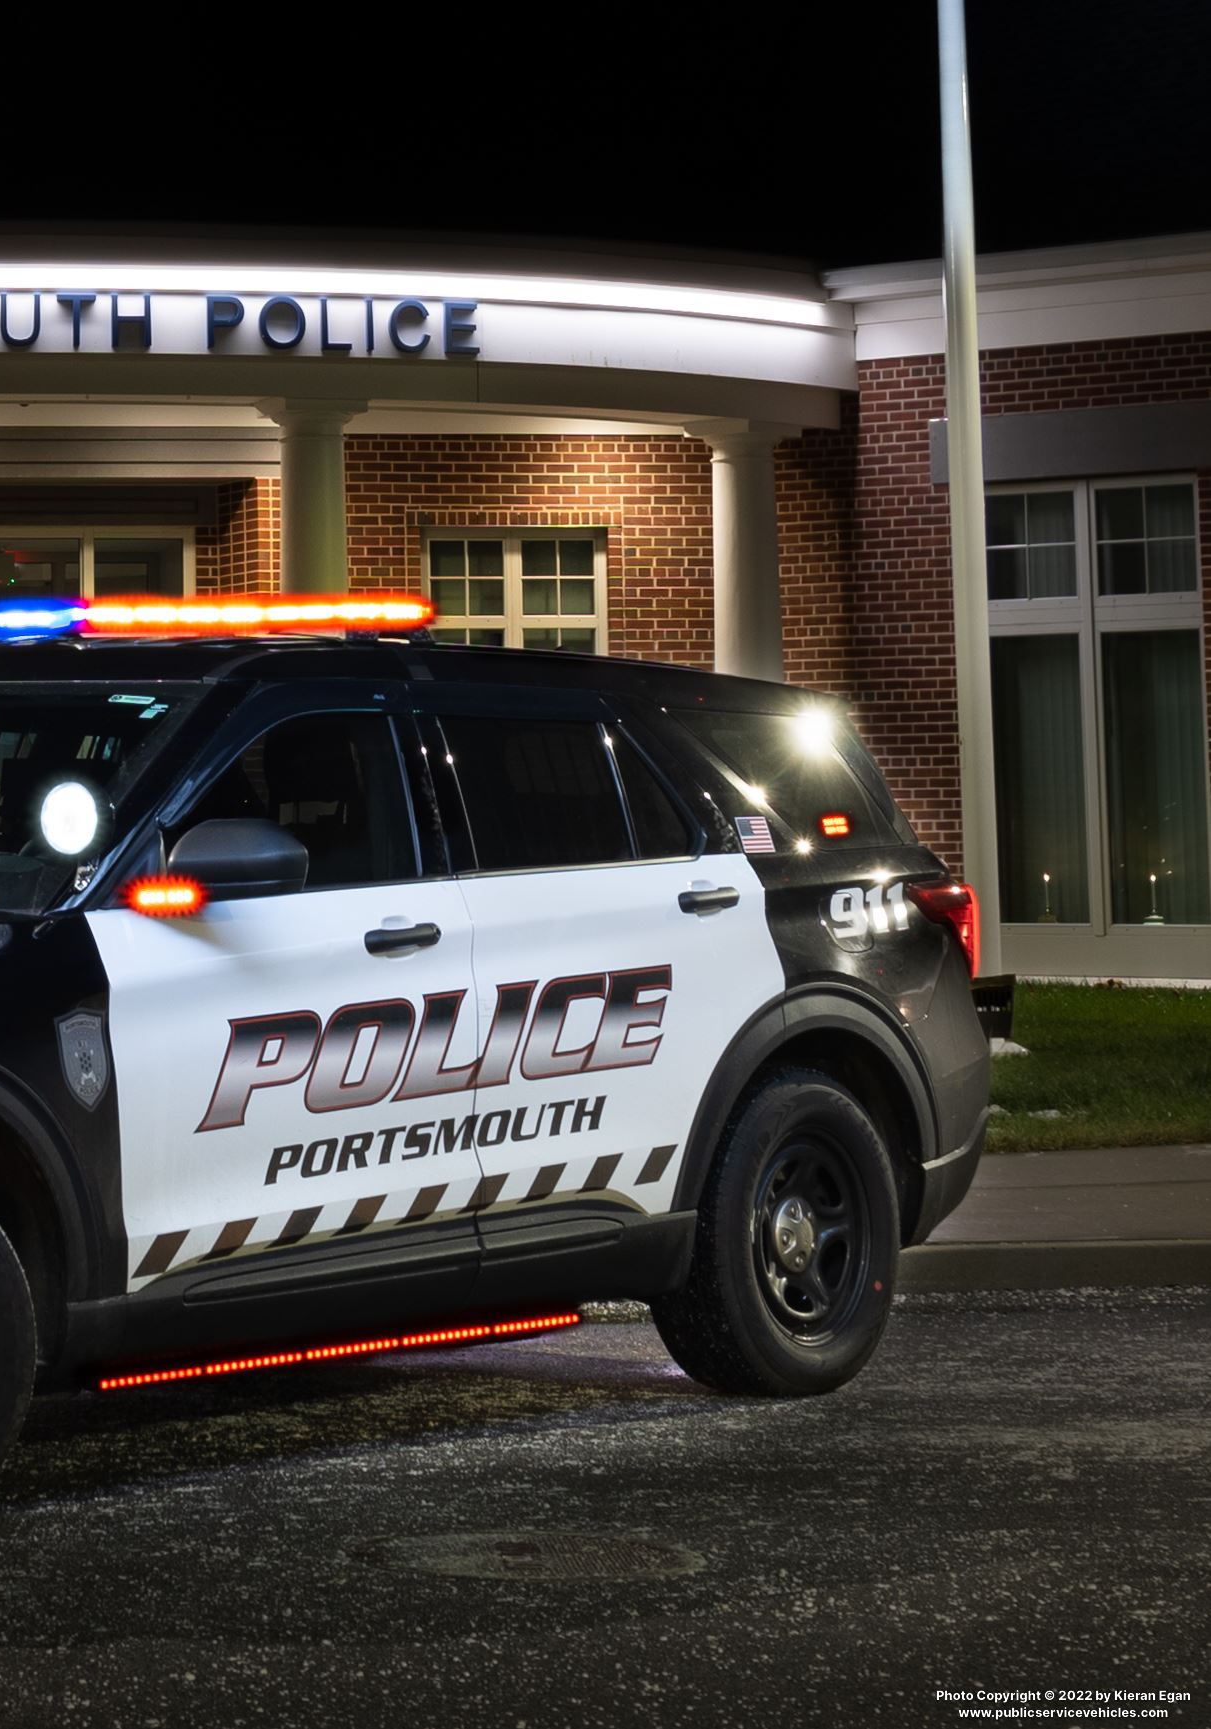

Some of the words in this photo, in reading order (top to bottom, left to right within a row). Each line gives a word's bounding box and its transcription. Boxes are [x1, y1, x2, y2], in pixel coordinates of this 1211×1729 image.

[206, 294, 481, 355] POLICE
[829, 881, 910, 939] 911
[193, 964, 673, 1134] POLICE
[264, 1095, 607, 1186] PORTSMOUTH
